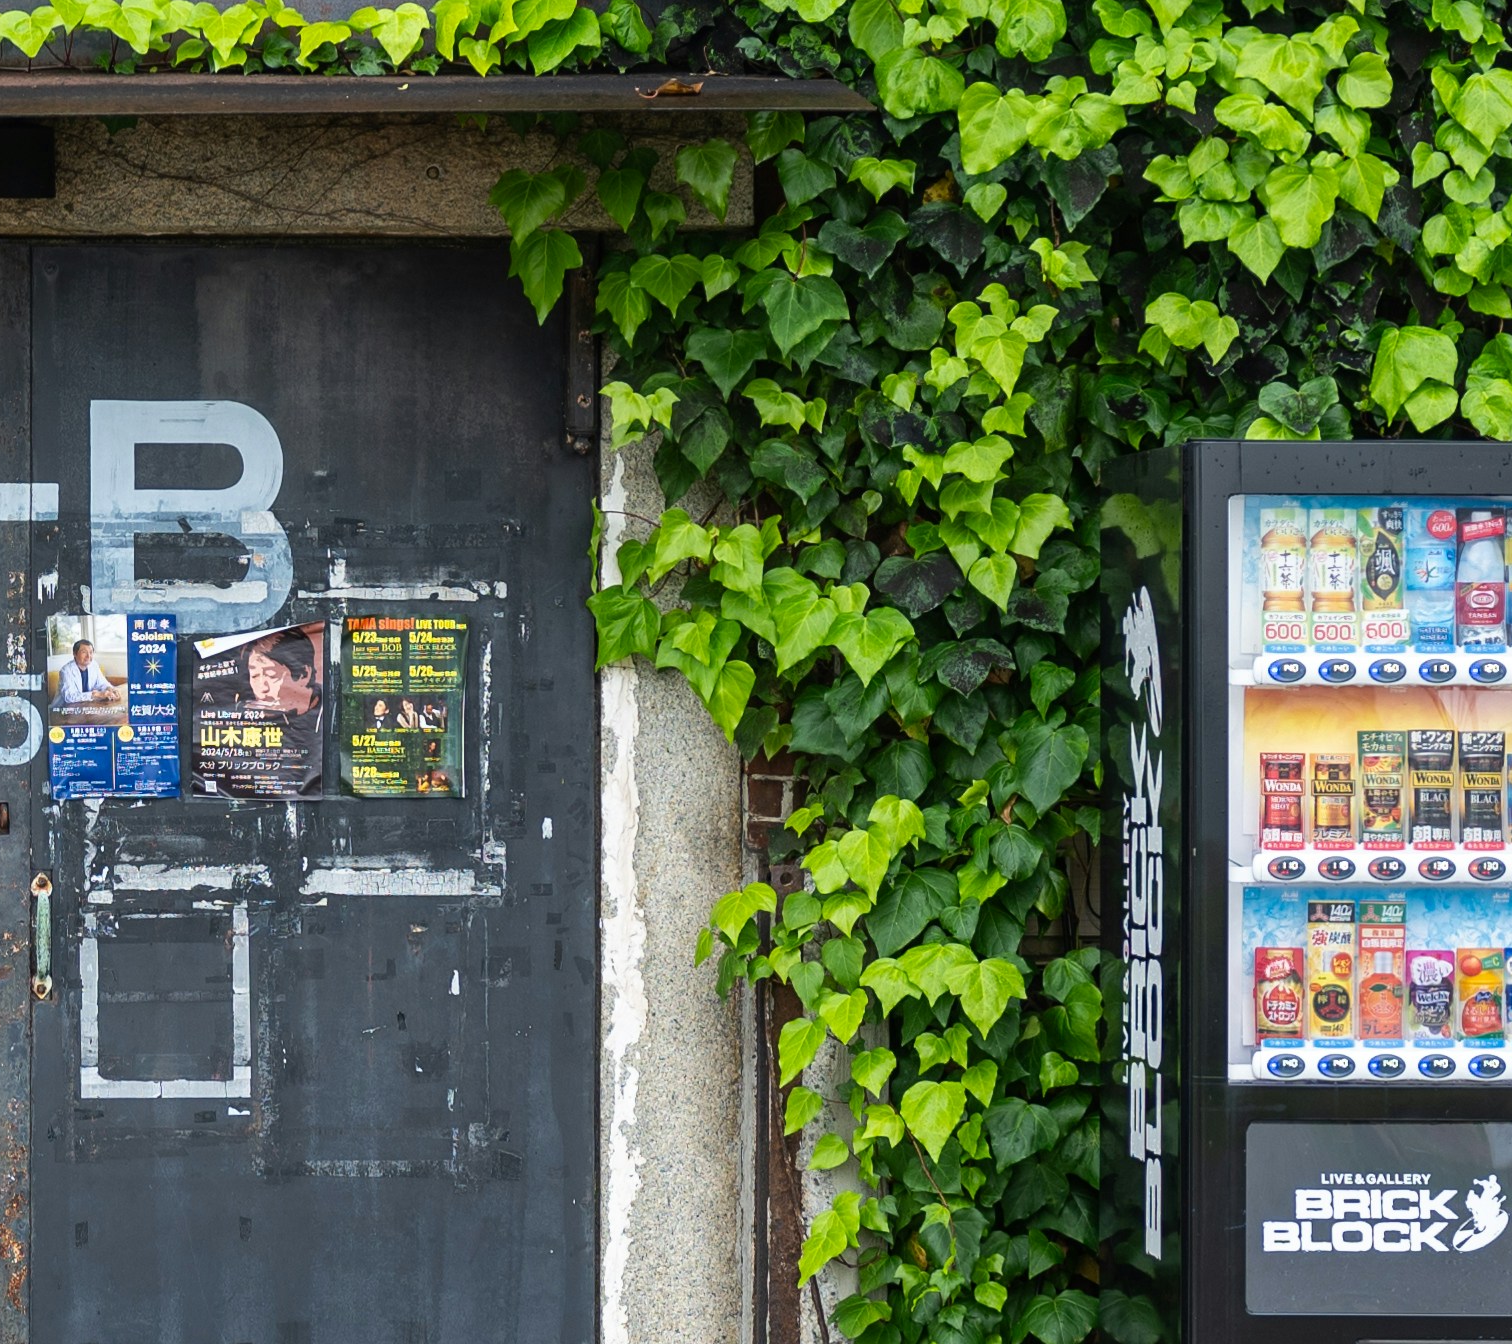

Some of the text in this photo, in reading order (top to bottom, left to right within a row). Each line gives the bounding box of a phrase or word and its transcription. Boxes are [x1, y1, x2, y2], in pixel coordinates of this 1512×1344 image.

[1279, 550, 1294, 590] 十六茶
[1327, 550, 1343, 590] 十六茶
[379, 617, 414, 630] sings!
[416, 620, 432, 629] LIVE
[433, 620, 455, 629] TOUR
[131, 632, 174, 641] Soloism
[353, 632, 377, 643] 5/23
[409, 632, 432, 643] 5/24
[139, 644, 166, 653] 2024
[352, 665, 376, 677] 5/25
[131, 704, 175, 716] 佐賀/大分
[244, 711, 265, 719] 2024
[200, 726, 283, 747] 山木康世
[352, 735, 375, 746] 5/27
[199, 761, 280, 770] 大分 ブリックブロック
[1365, 774, 1400, 785] WONDA
[1416, 773, 1451, 784] WONDA
[1466, 774, 1500, 785] WONDA
[1265, 780, 1302, 792] WONDA
[1315, 780, 1352, 792] WONDA
[1130, 722, 1146, 1162] BRICK
[1146, 749, 1163, 1260] BLOCK
[1295, 1189, 1459, 1220] BRICK
[1262, 1221, 1450, 1252] BLOCK
